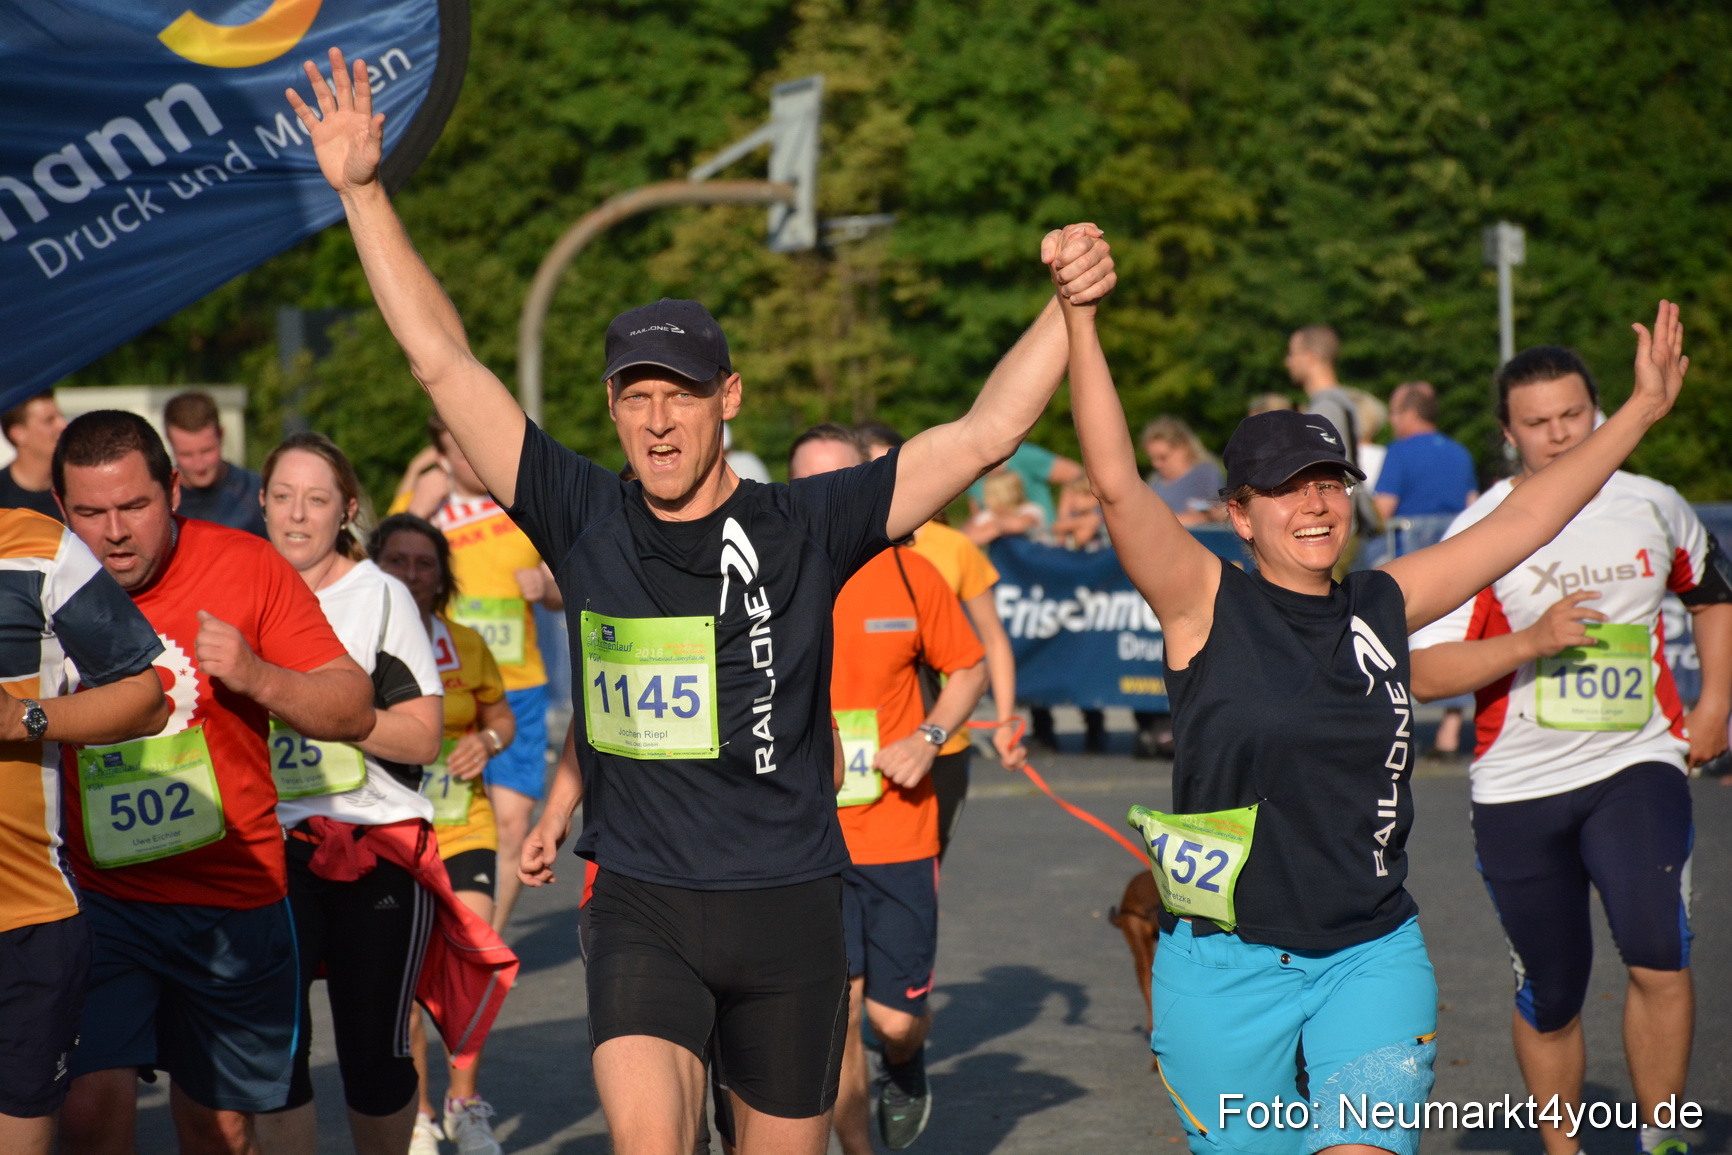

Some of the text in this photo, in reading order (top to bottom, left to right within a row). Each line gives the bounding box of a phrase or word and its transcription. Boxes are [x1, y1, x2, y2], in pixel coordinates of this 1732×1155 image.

[28, 187, 164, 279] Druck
[167, 140, 256, 200] und
[1527, 548, 1655, 598] Xplus1
[635, 648, 664, 658] 2016
[594, 671, 700, 719] 1145
[1549, 666, 1643, 700] 1602
[618, 727, 668, 740] Jochen Riepl
[110, 781, 195, 831] 502
[132, 835, 151, 846] Uwe
[152, 829, 182, 844] Eichler
